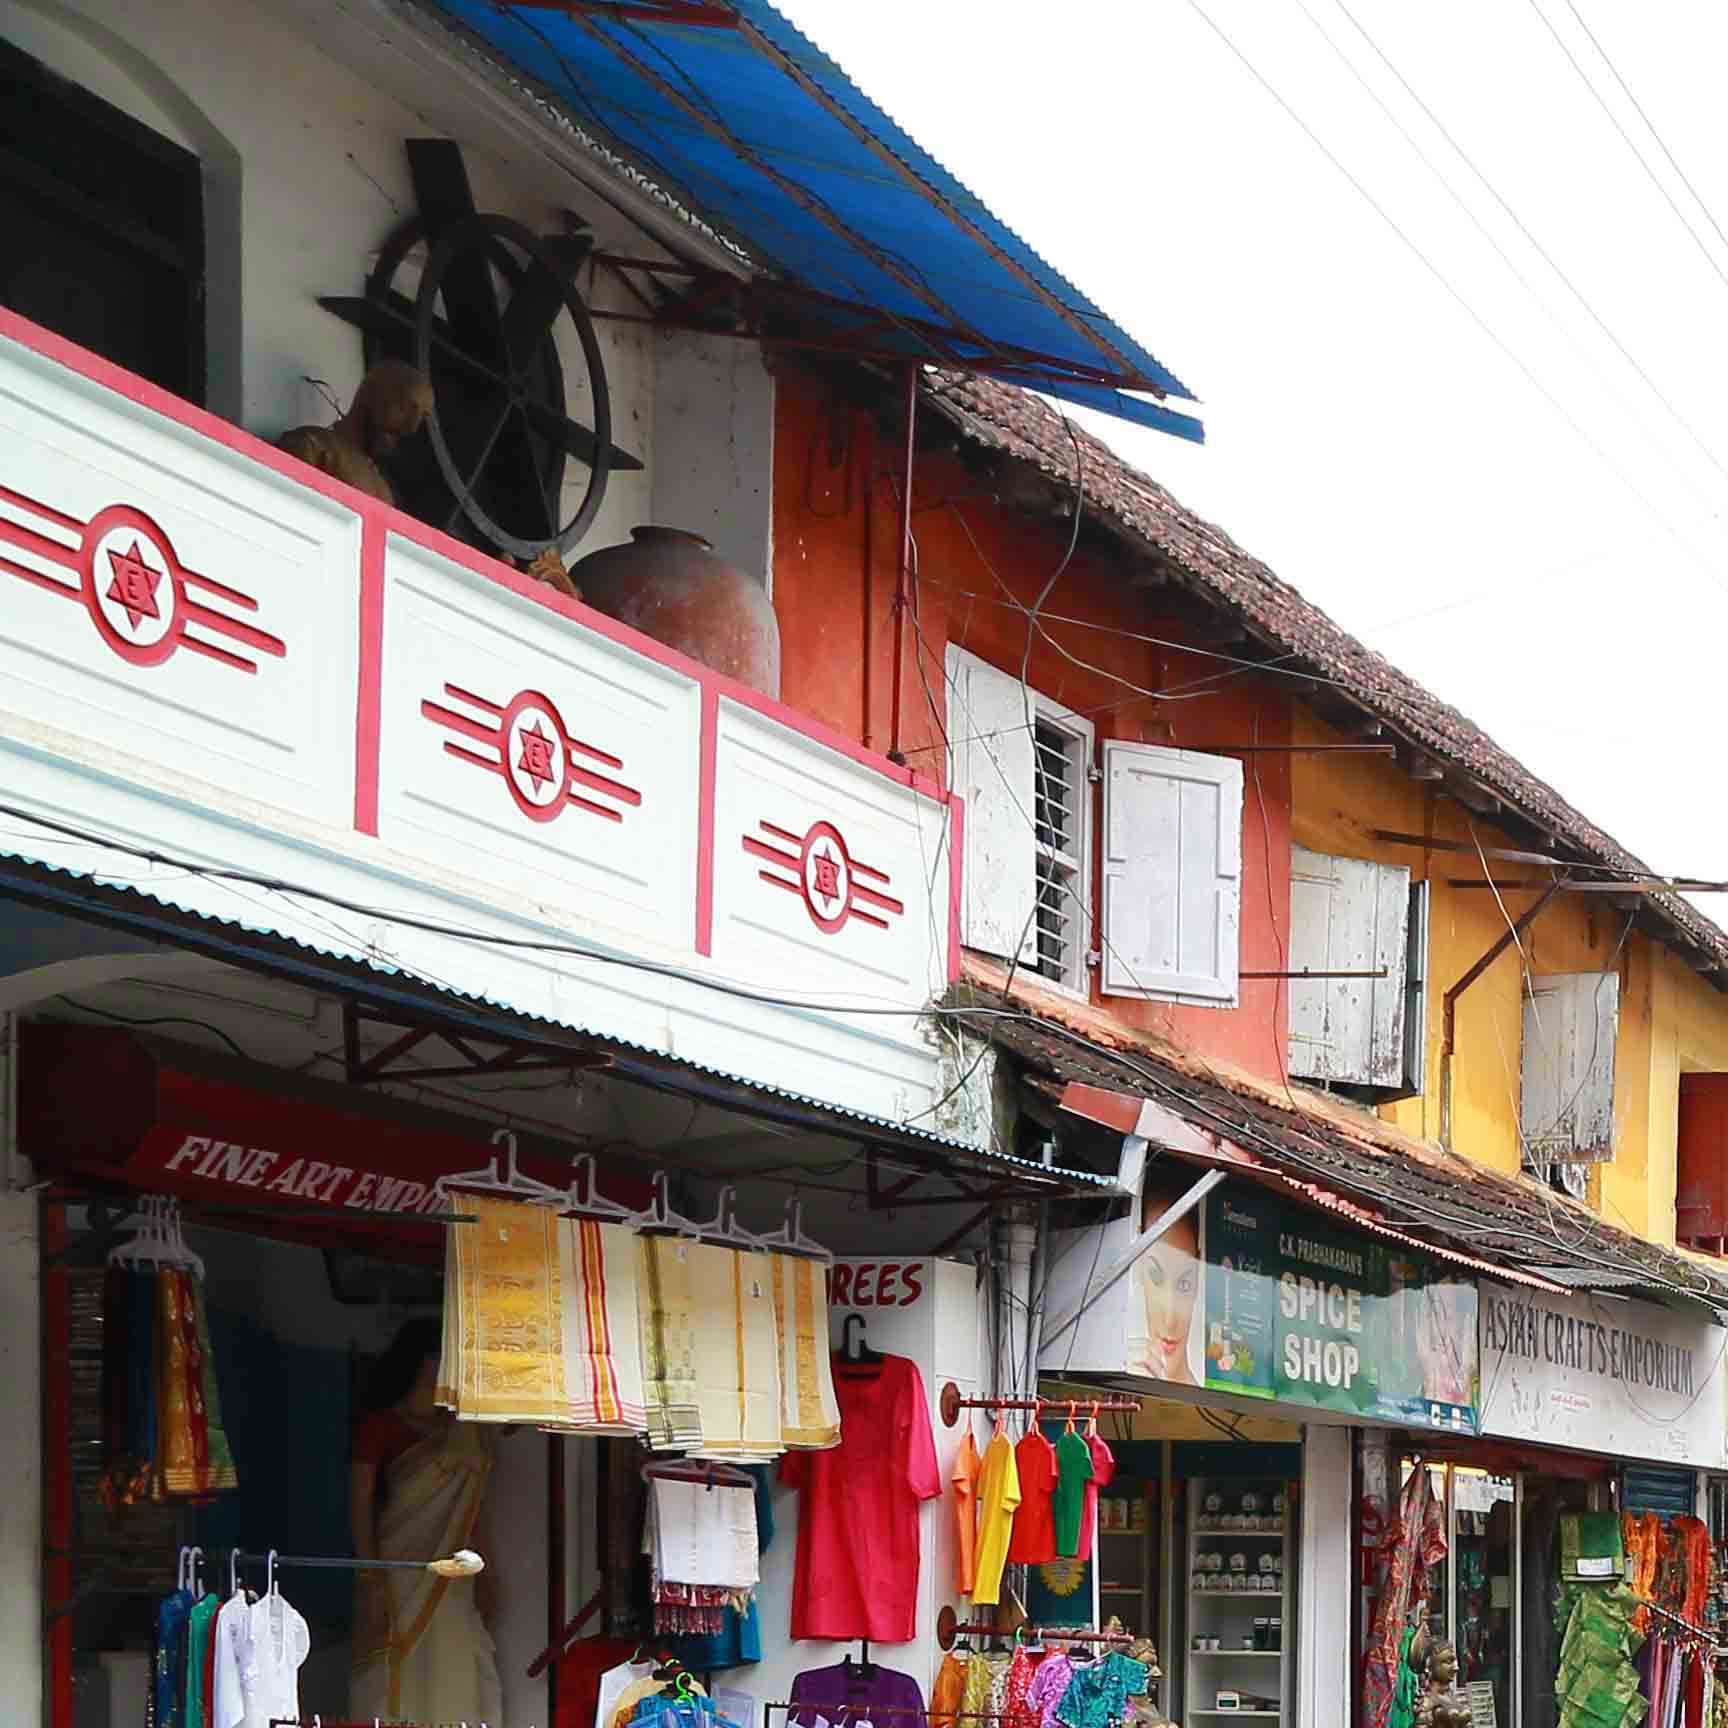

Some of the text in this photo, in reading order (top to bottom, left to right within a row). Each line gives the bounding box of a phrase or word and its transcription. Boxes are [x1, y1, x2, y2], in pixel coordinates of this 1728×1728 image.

[164, 1135, 450, 1215] FINE ART EMPO
[1279, 1271, 1362, 1334] SPICE
[1283, 1332, 1361, 1389] SHOP
[1484, 1297, 1695, 1397] ASIAN CRAFTS EMPORIUM
